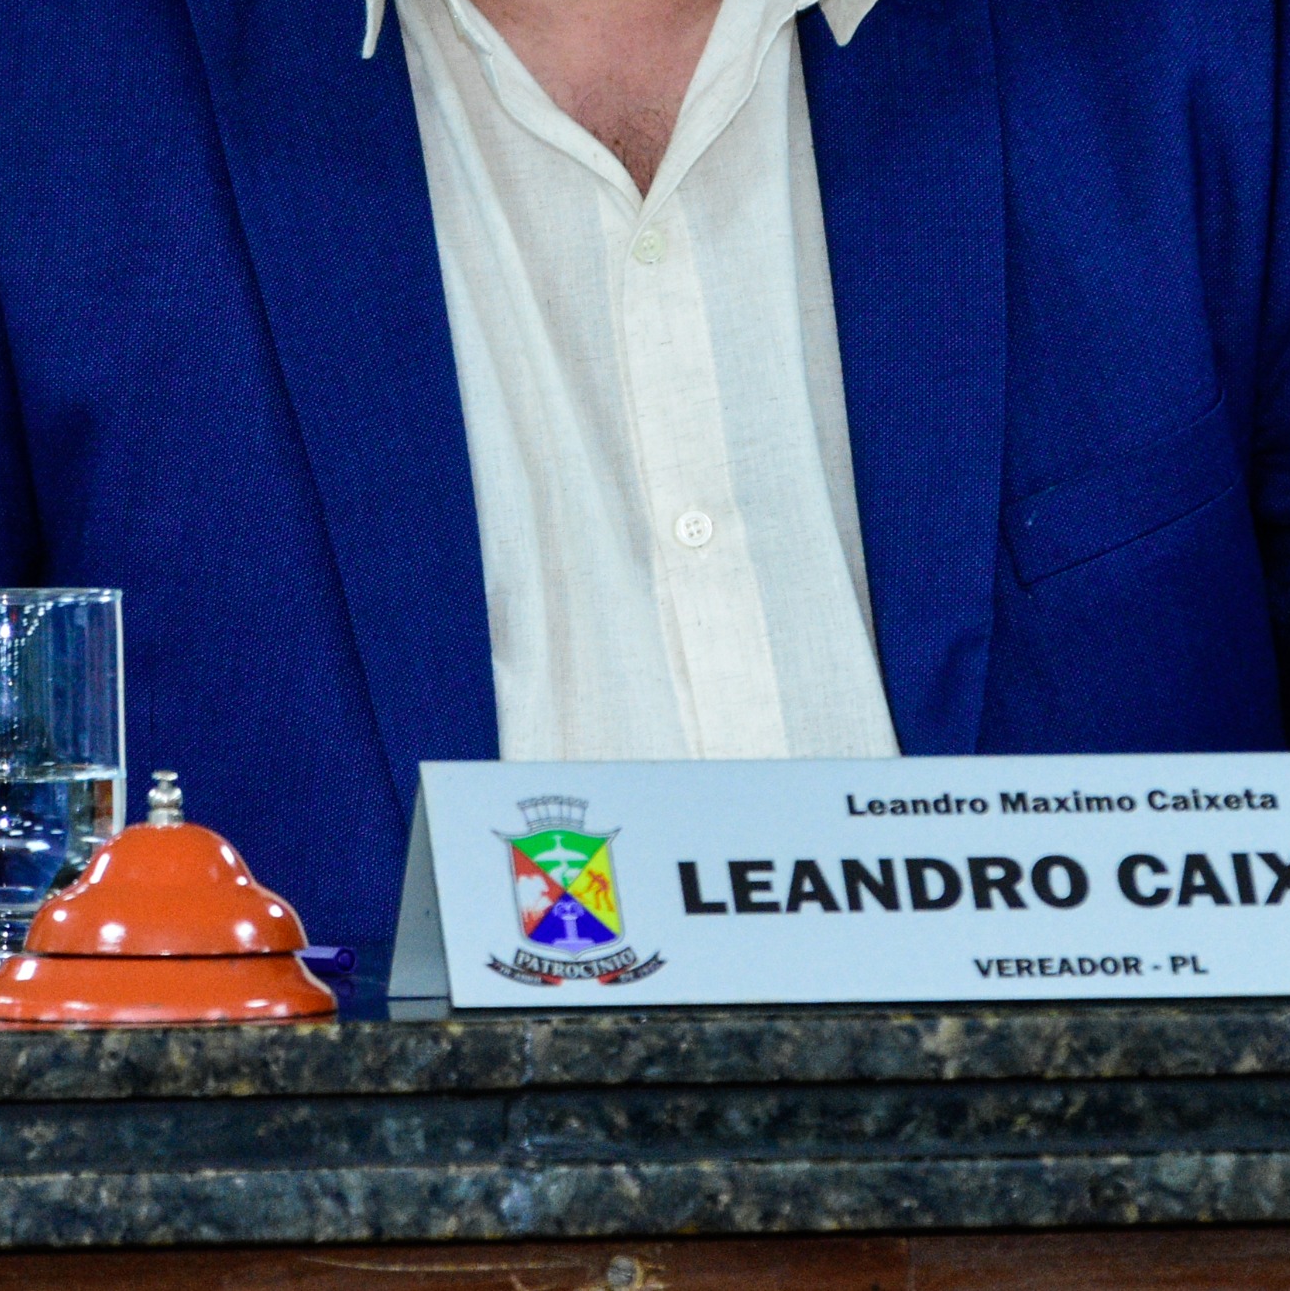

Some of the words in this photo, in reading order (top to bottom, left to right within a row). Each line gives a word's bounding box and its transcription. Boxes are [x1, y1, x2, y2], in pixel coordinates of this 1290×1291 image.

[845, 792, 990, 818] Leandro
[998, 789, 1138, 816] Maximo
[1146, 787, 1280, 813] Caixeta
[676, 853, 1091, 917] LEANDRO
[972, 955, 1143, 979] VEREADOR
[1169, 954, 1209, 975] PL
